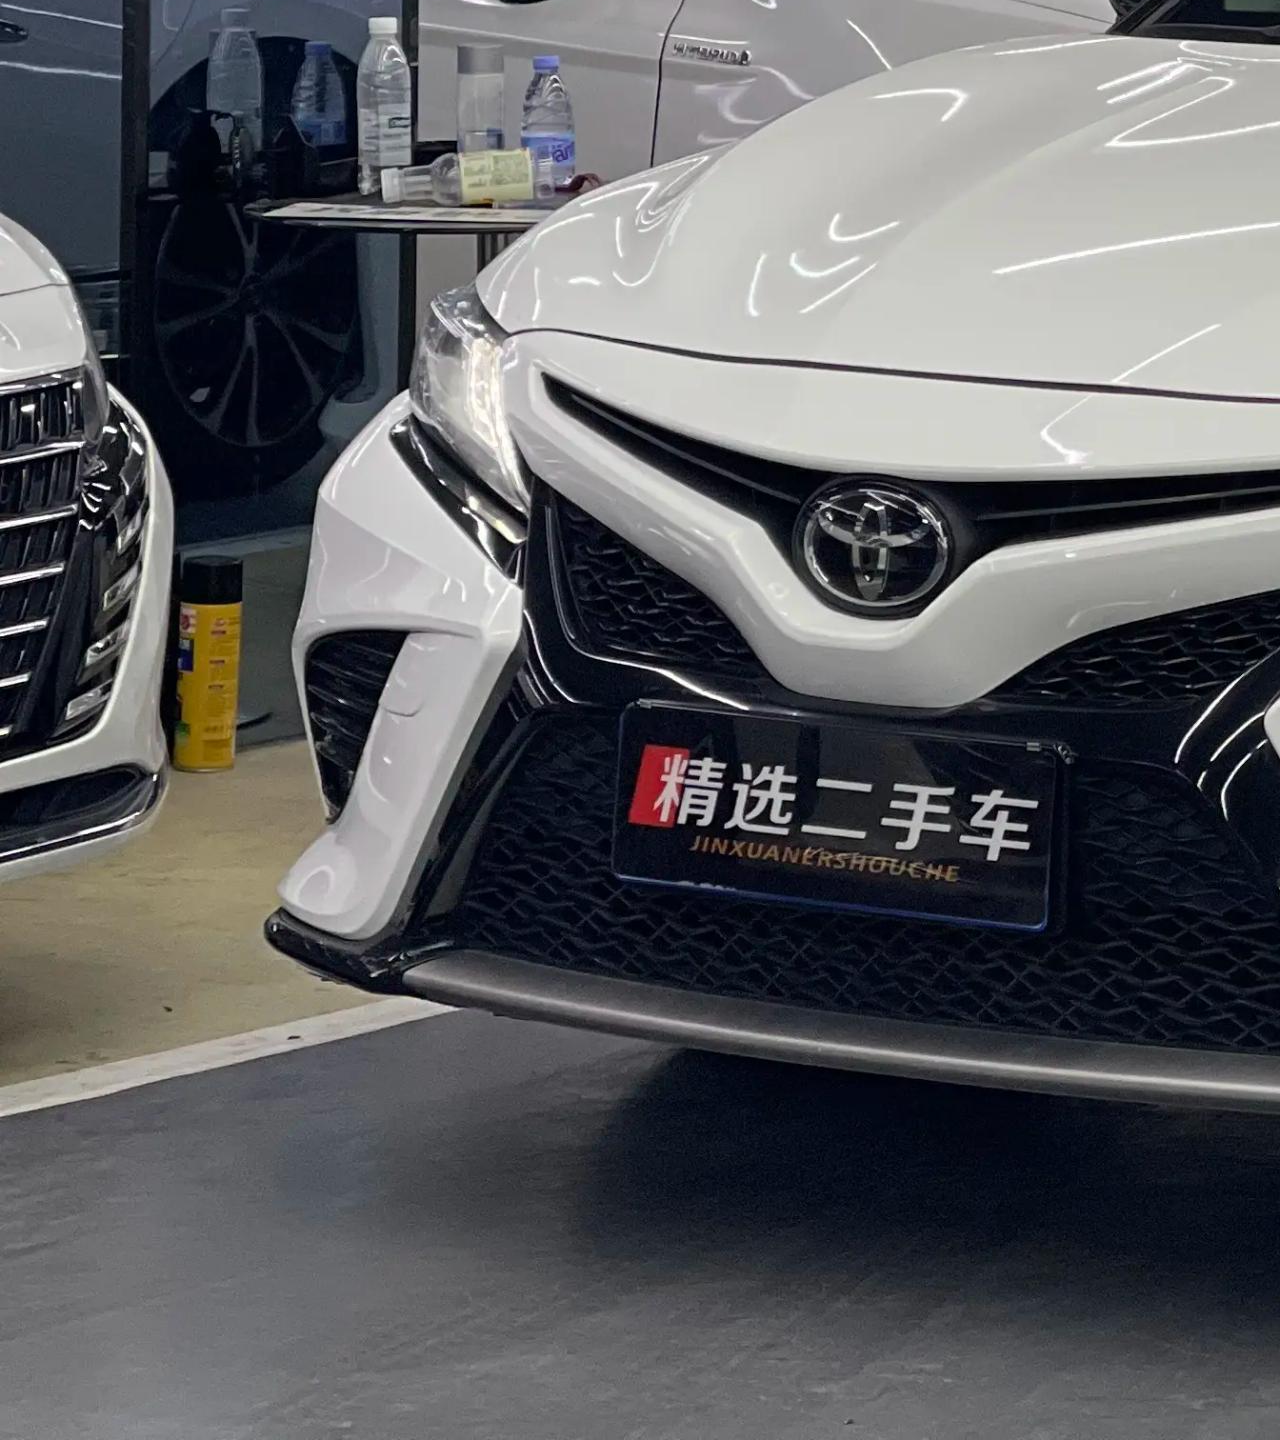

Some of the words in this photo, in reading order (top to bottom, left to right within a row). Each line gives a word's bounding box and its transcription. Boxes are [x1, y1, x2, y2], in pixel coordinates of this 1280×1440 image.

[652, 753, 1039, 862] 精选二手车
[689, 835, 961, 882] JINXUANERSHOUCHE
